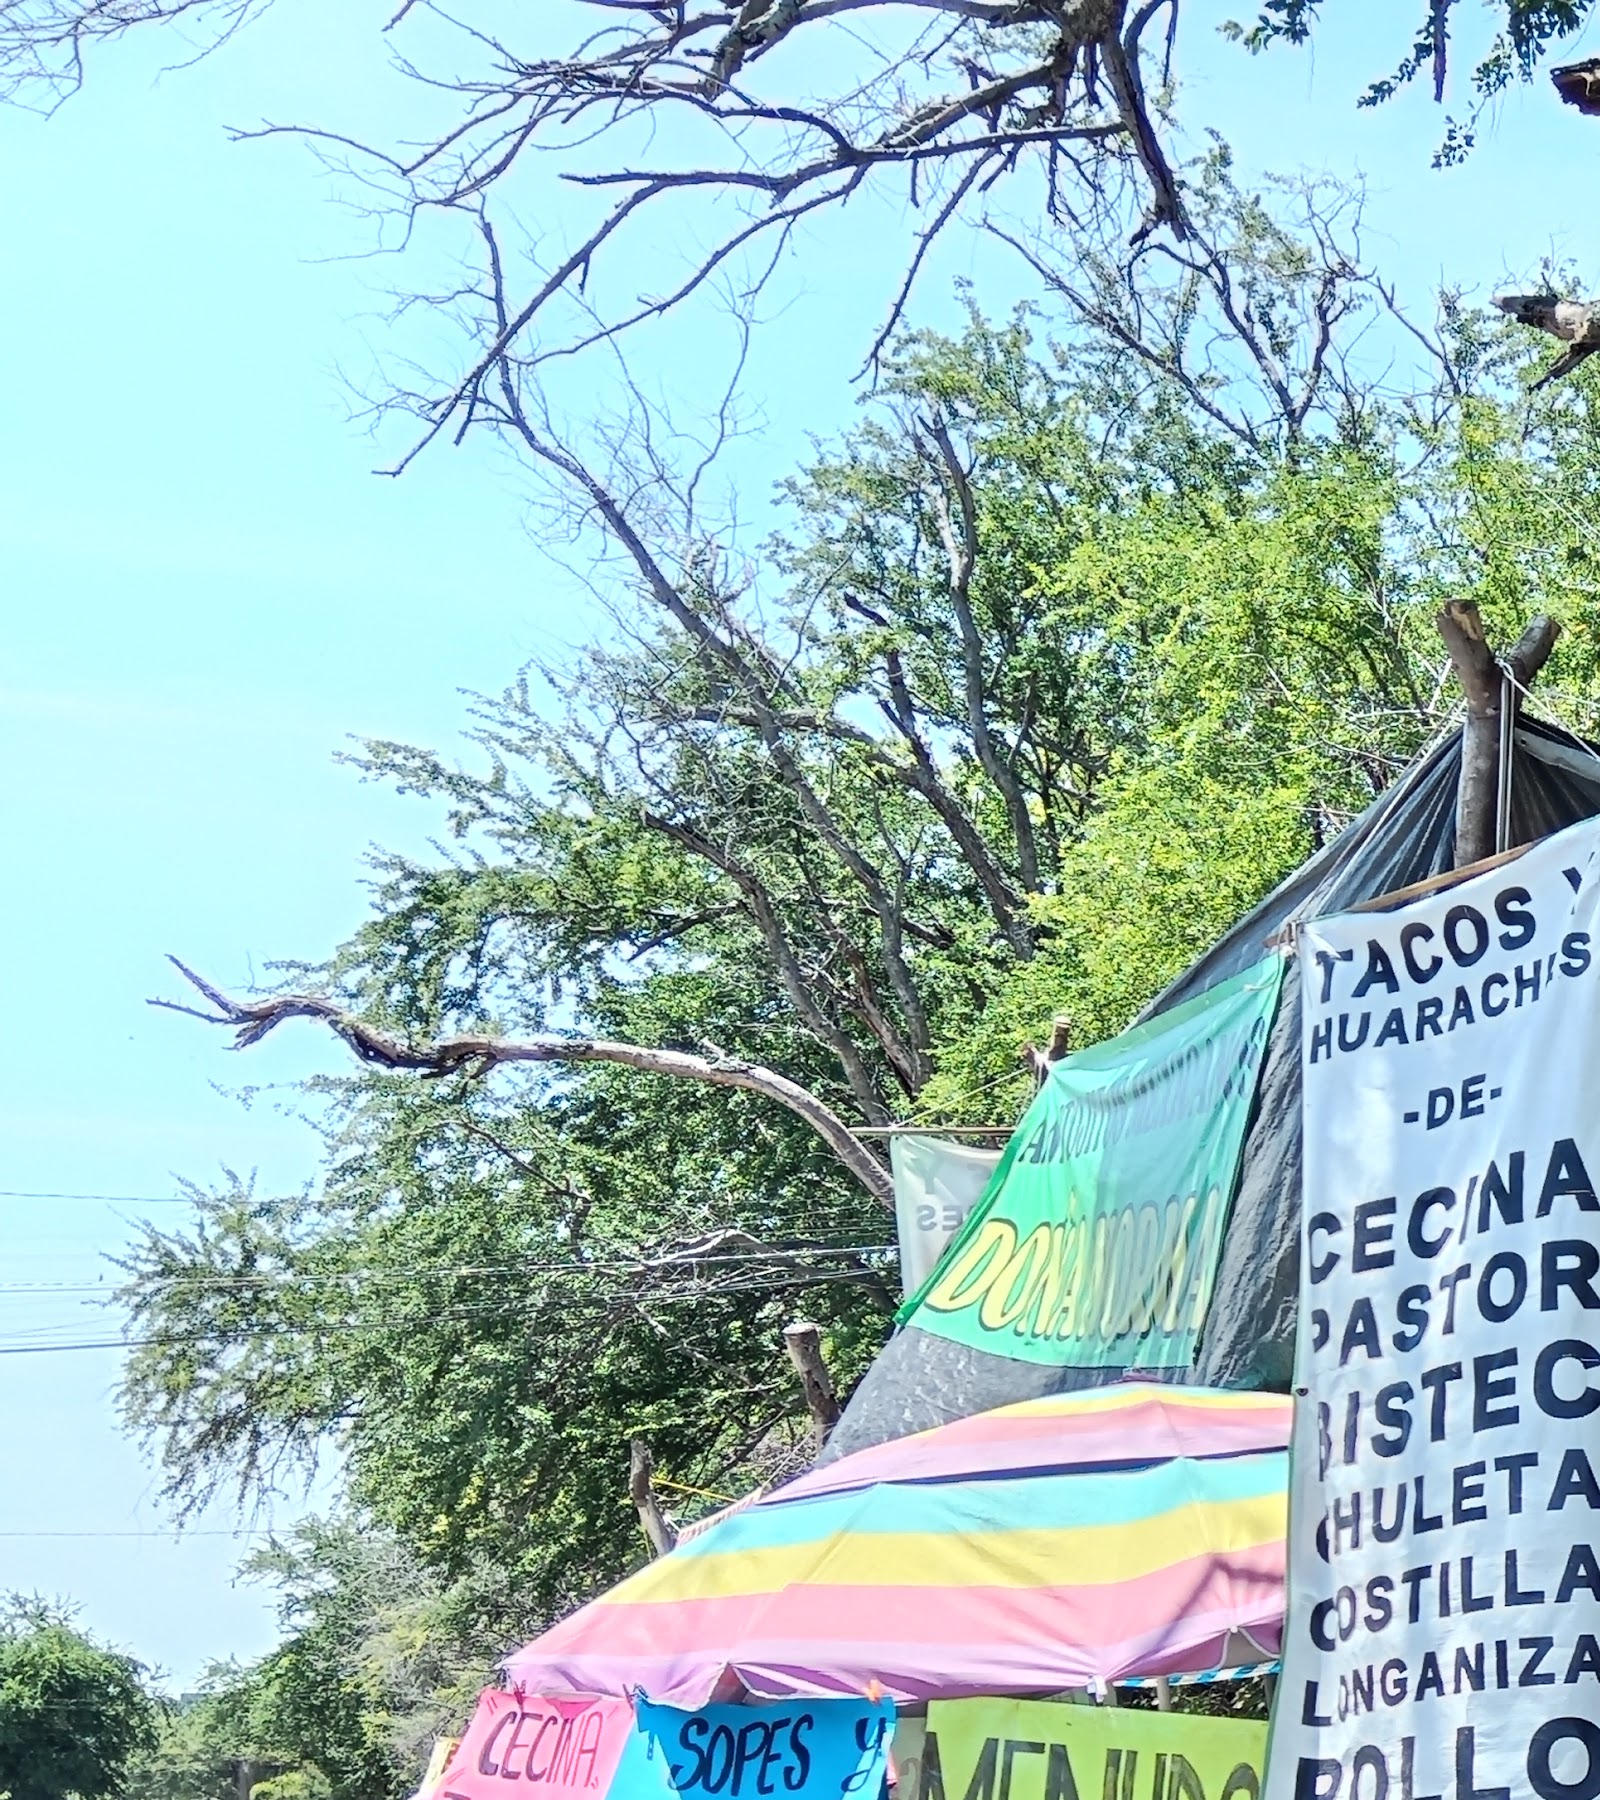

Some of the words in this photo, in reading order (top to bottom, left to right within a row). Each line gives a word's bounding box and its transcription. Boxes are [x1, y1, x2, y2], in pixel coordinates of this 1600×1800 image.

[1315, 886, 1537, 1003] TACOS
[1310, 931, 1592, 1064] HUARACHS
[478, 1711, 603, 1788] CECINA
[668, 1714, 814, 1797] SOPES
